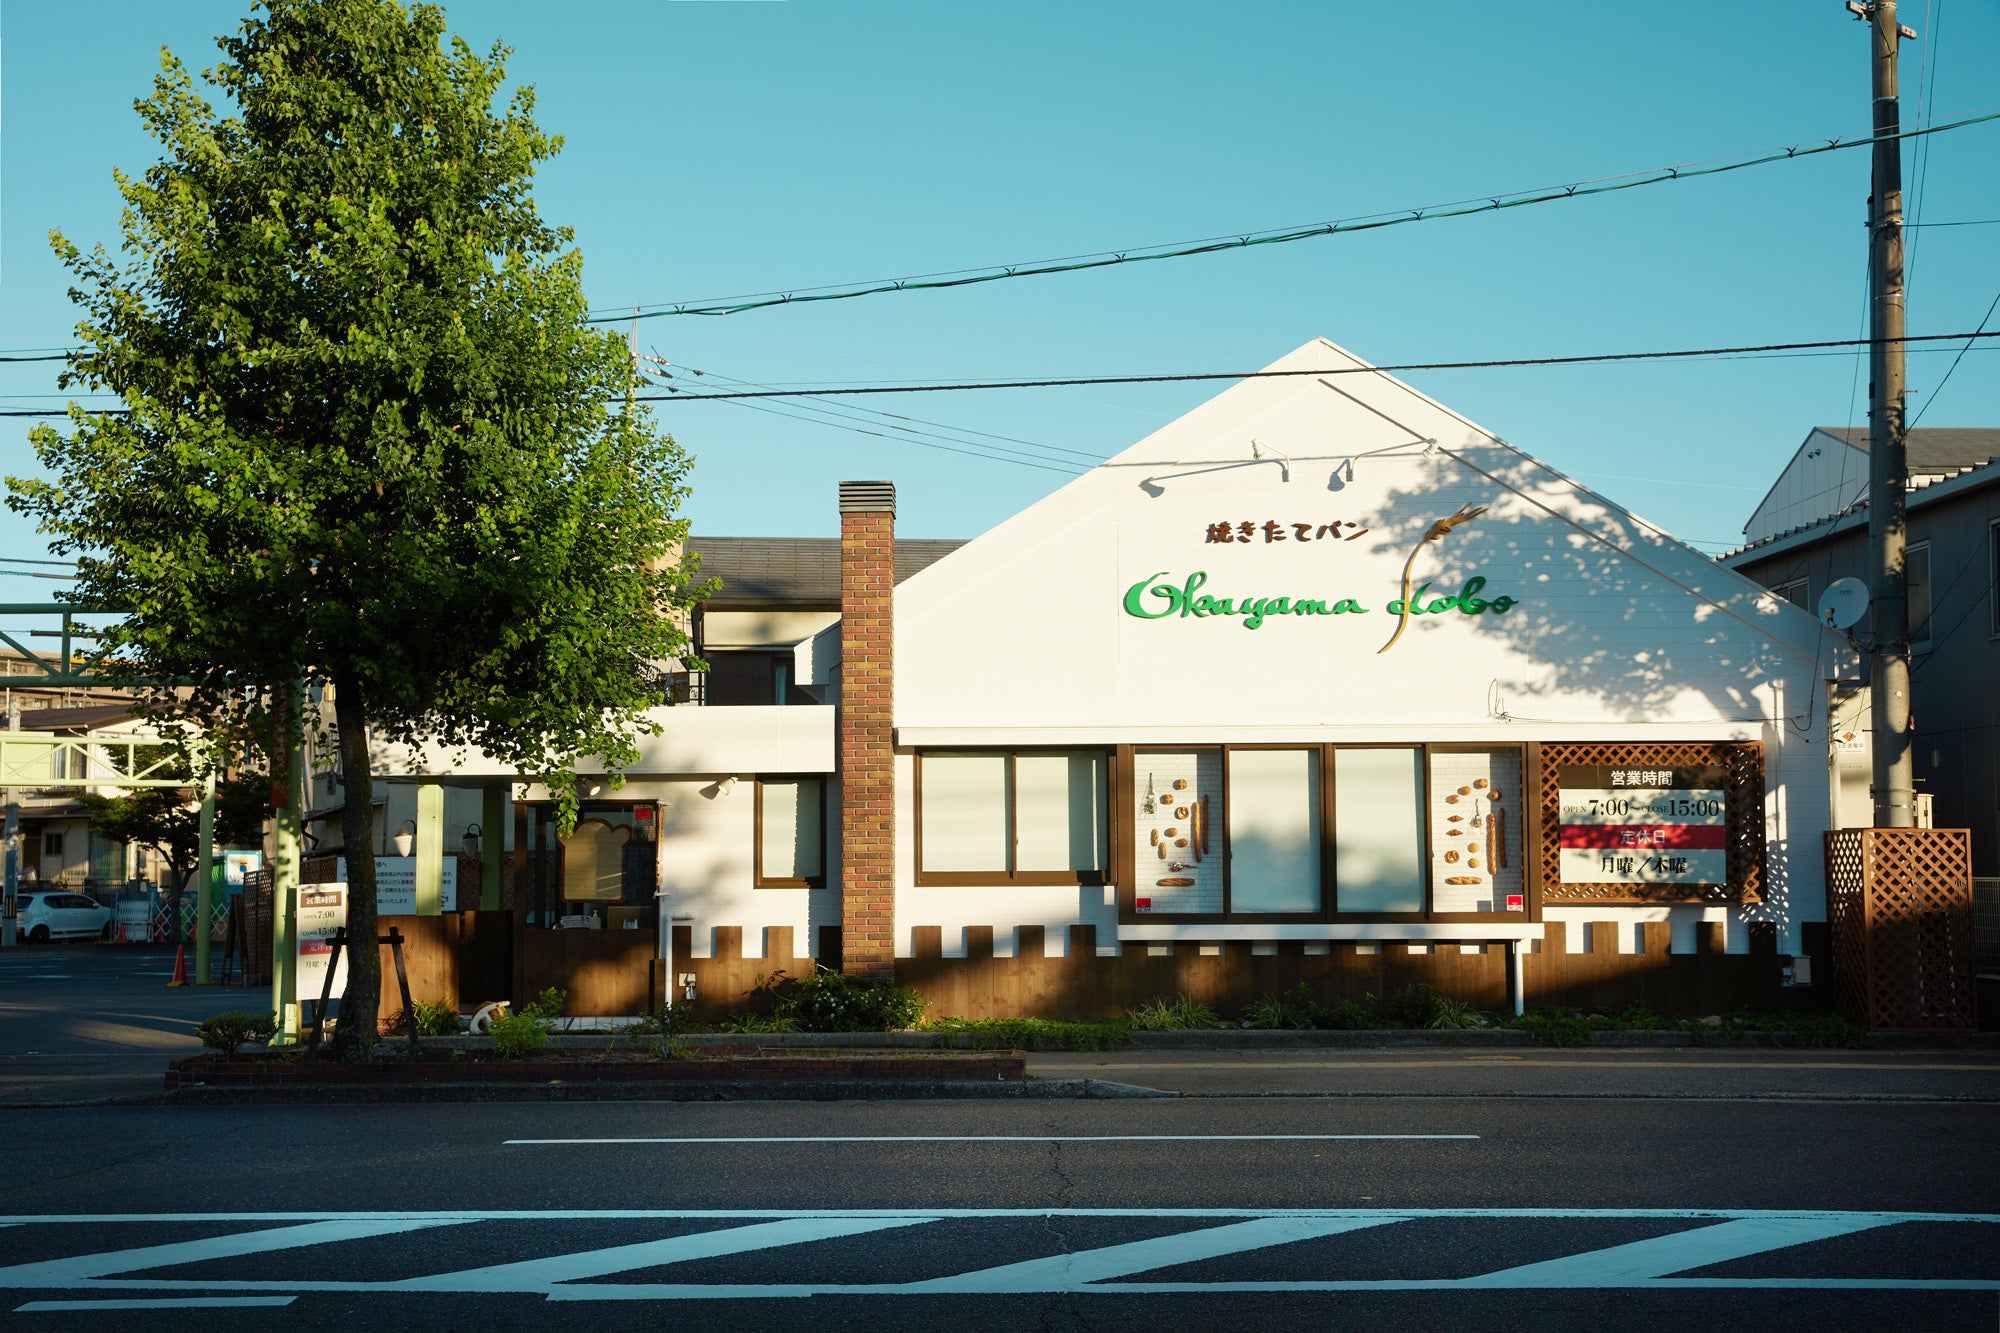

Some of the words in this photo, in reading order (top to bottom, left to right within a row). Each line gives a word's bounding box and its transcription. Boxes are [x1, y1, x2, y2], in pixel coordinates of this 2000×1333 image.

[1206, 519, 1369, 544] 焼きたてパン
[1123, 570, 1370, 630] Okayama
[1611, 770, 1673, 786] 営業時間
[1563, 805, 1587, 813] OPEN
[1640, 805, 1669, 814] CLOSE
[1669, 799, 1719, 816] 15:00
[1620, 829, 1666, 845] 定休日
[306, 895, 337, 905] 営業時間
[317, 911, 335, 919] 7:00
